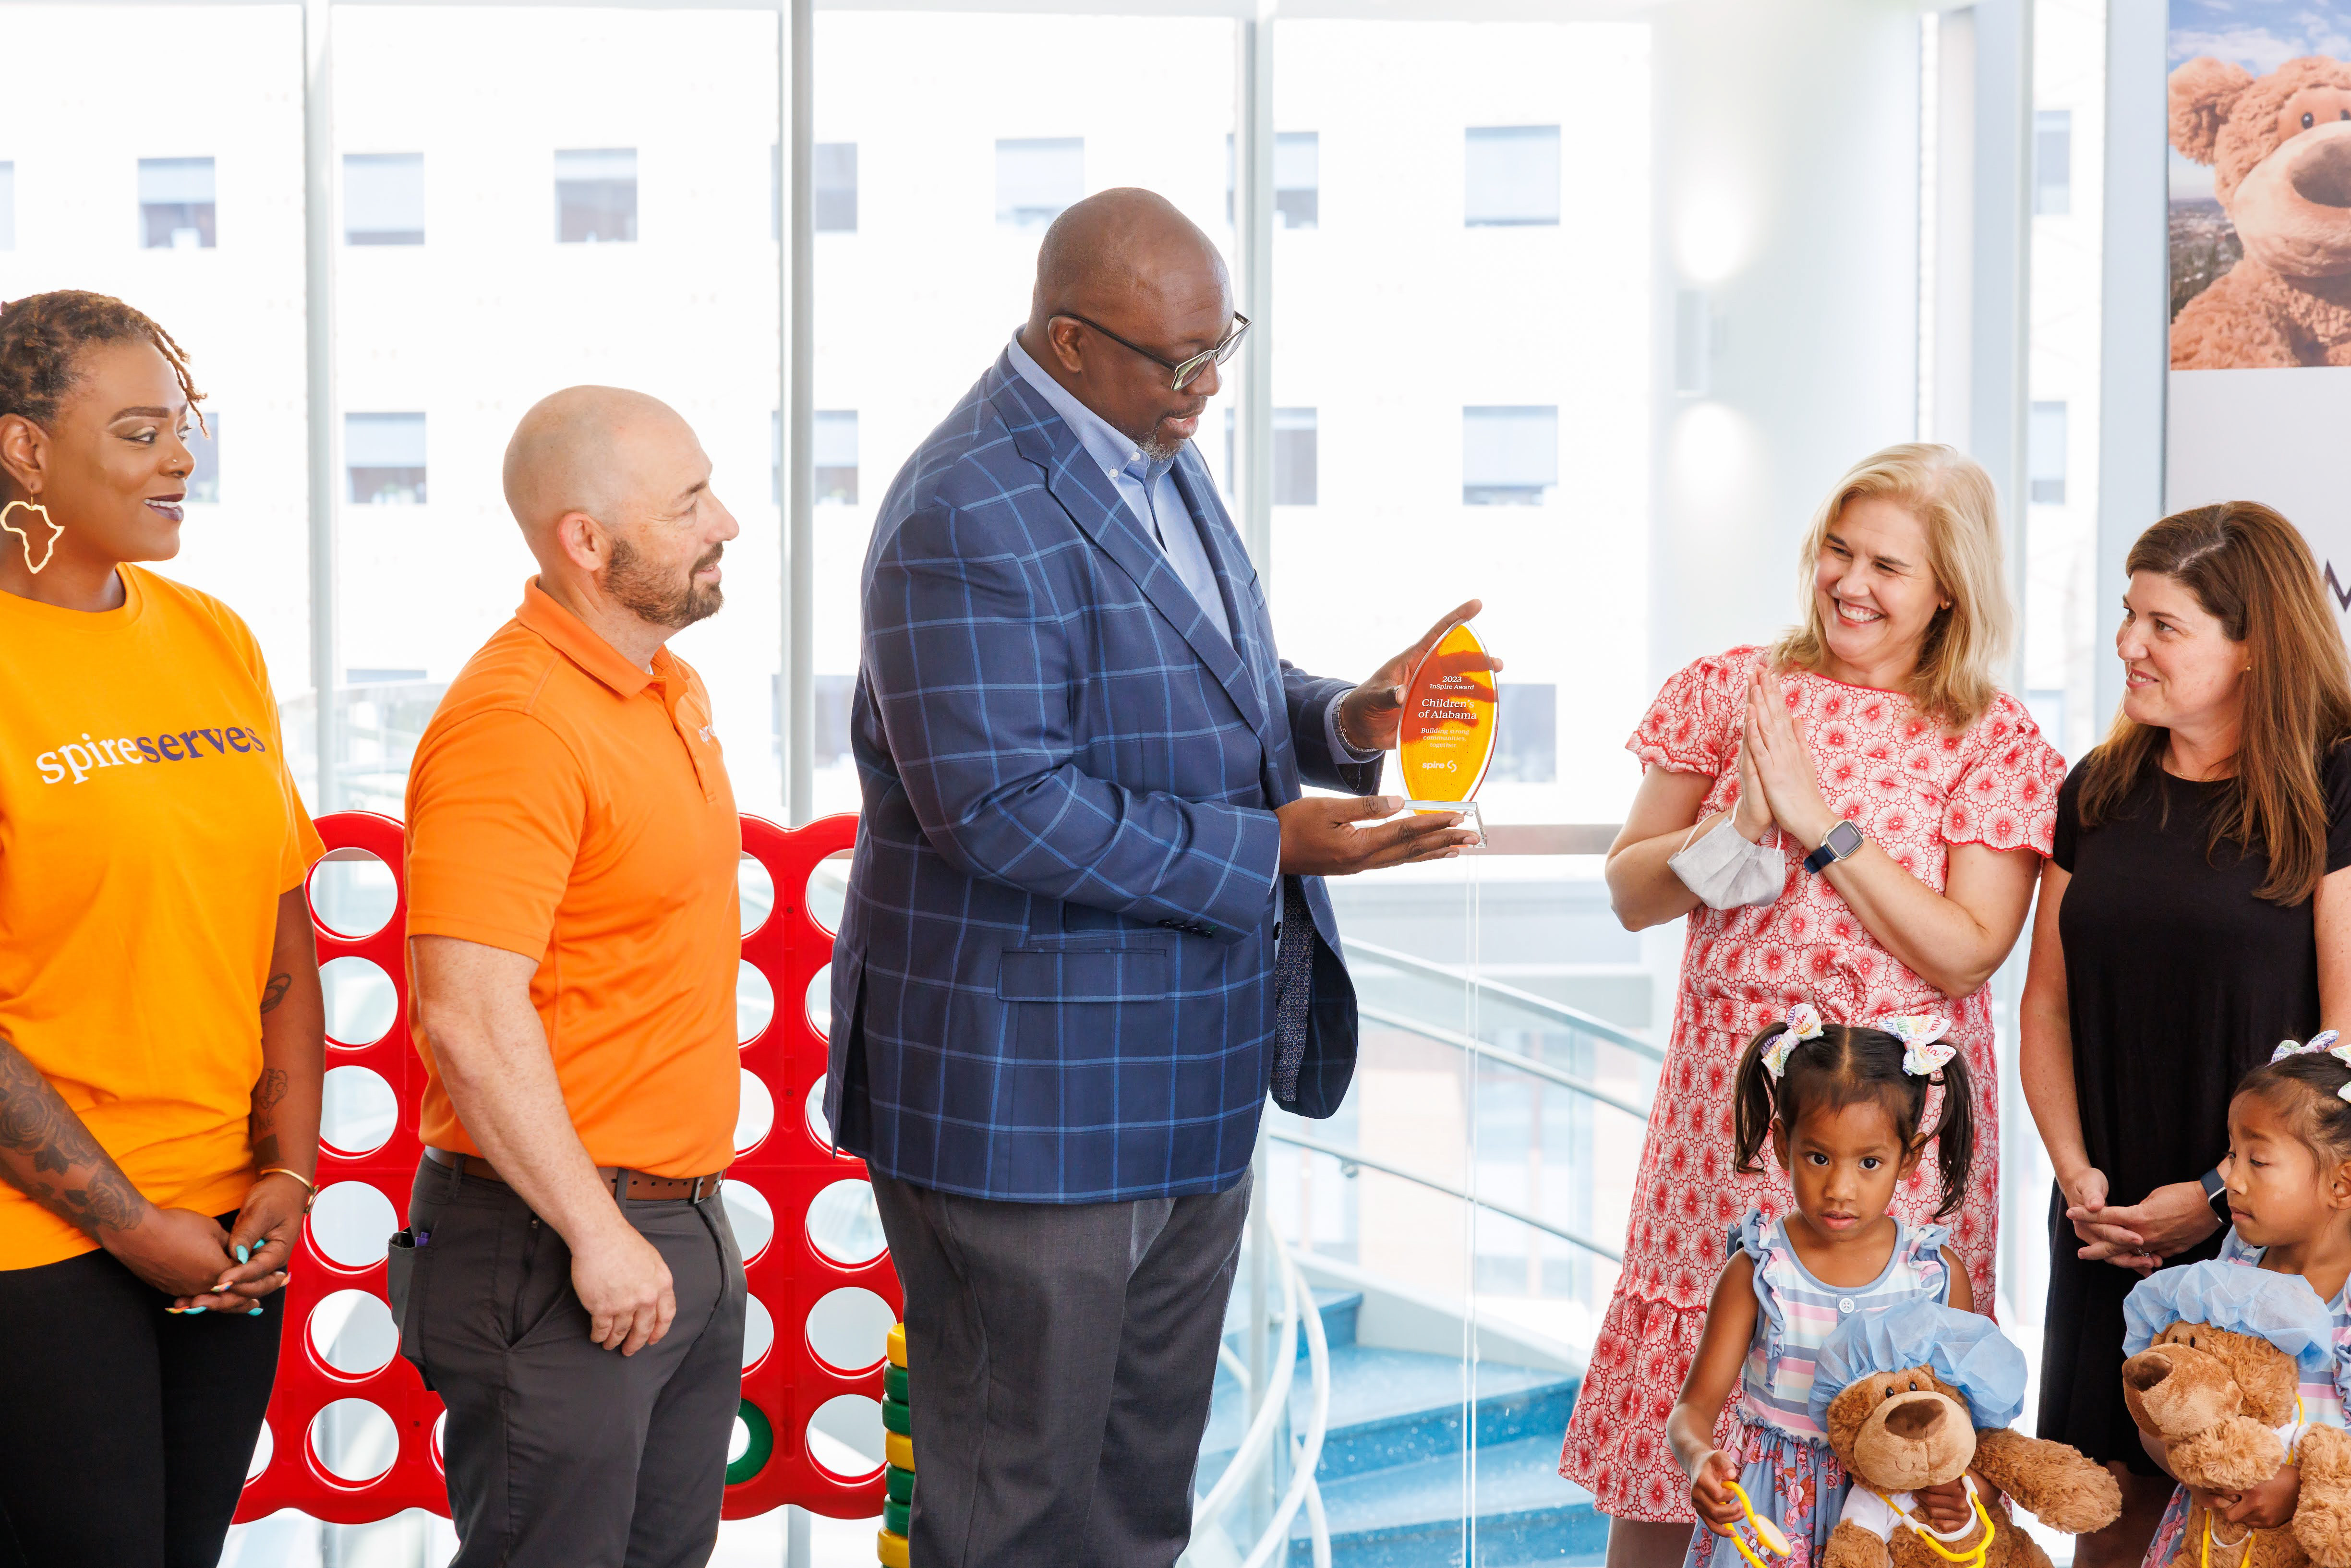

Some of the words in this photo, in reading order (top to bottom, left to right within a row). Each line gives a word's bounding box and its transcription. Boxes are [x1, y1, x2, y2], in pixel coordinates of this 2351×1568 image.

[1422, 699, 1474, 708] Children's
[1418, 710, 1430, 718] of
[1431, 711, 1477, 719] Alabama
[36, 726, 265, 784] spireserves
[1423, 761, 1445, 770] spire
